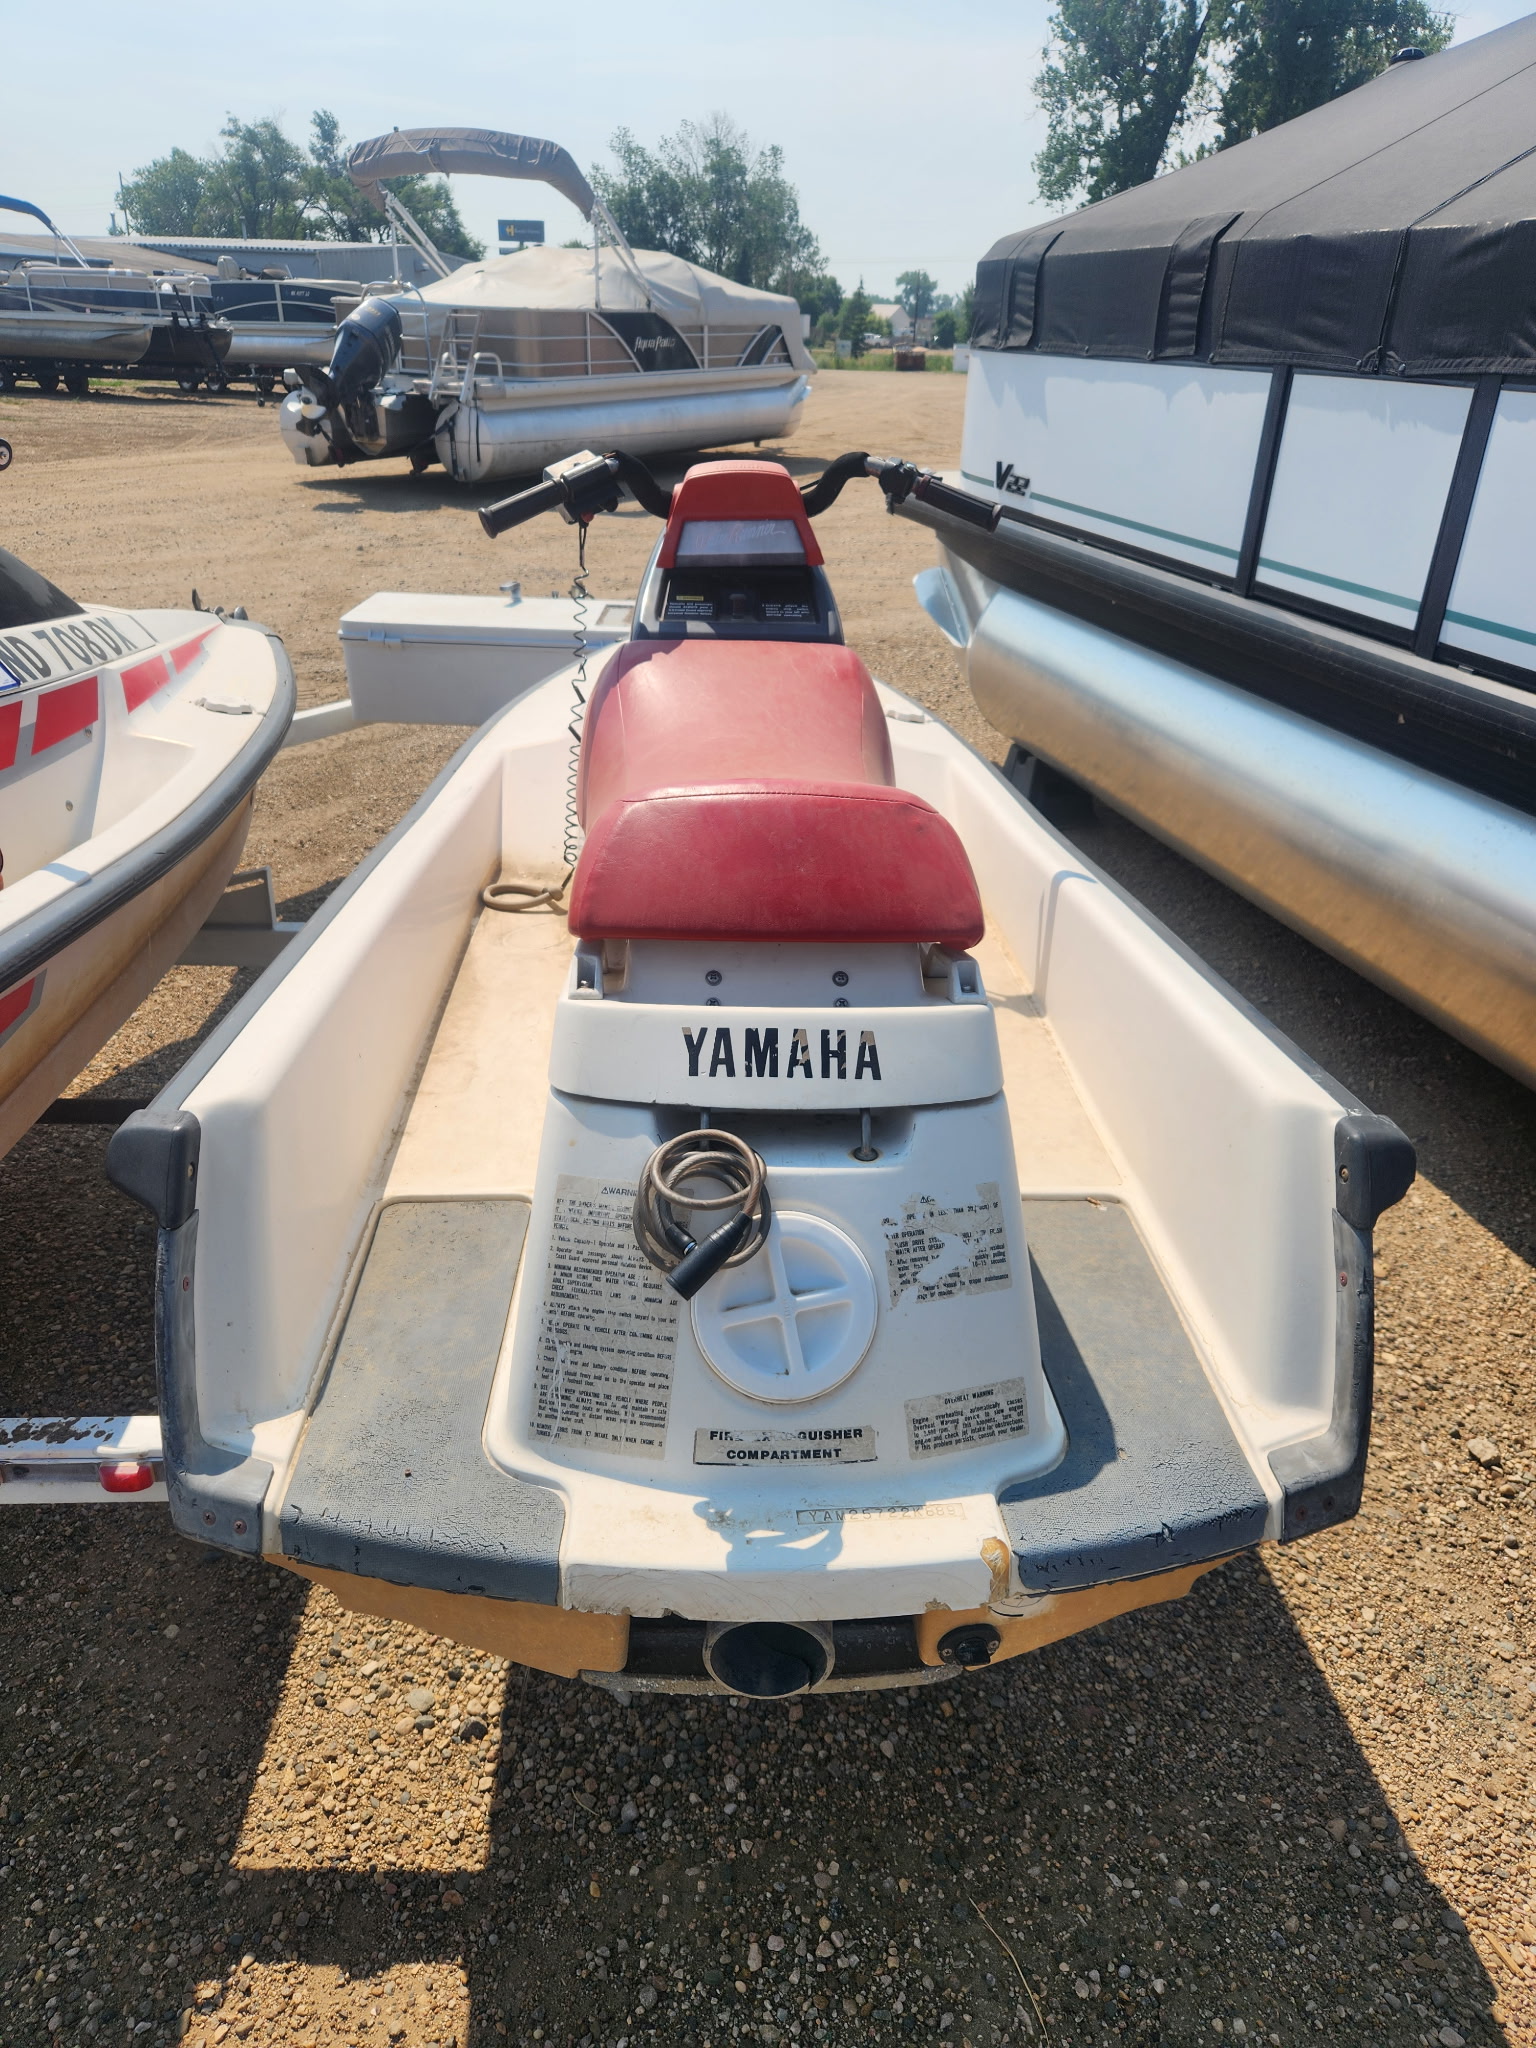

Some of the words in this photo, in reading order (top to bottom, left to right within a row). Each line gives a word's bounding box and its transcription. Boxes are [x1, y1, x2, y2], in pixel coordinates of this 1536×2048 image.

[681, 1027, 882, 1080] YAMAHA
[944, 1393, 969, 1405] OVERHEAT
[971, 1389, 994, 1399] WARNING
[912, 1417, 929, 1425] Engine
[935, 1410, 963, 1421] overheating
[944, 1431, 959, 1439] check
[726, 1448, 842, 1459] COMPARTMENT
